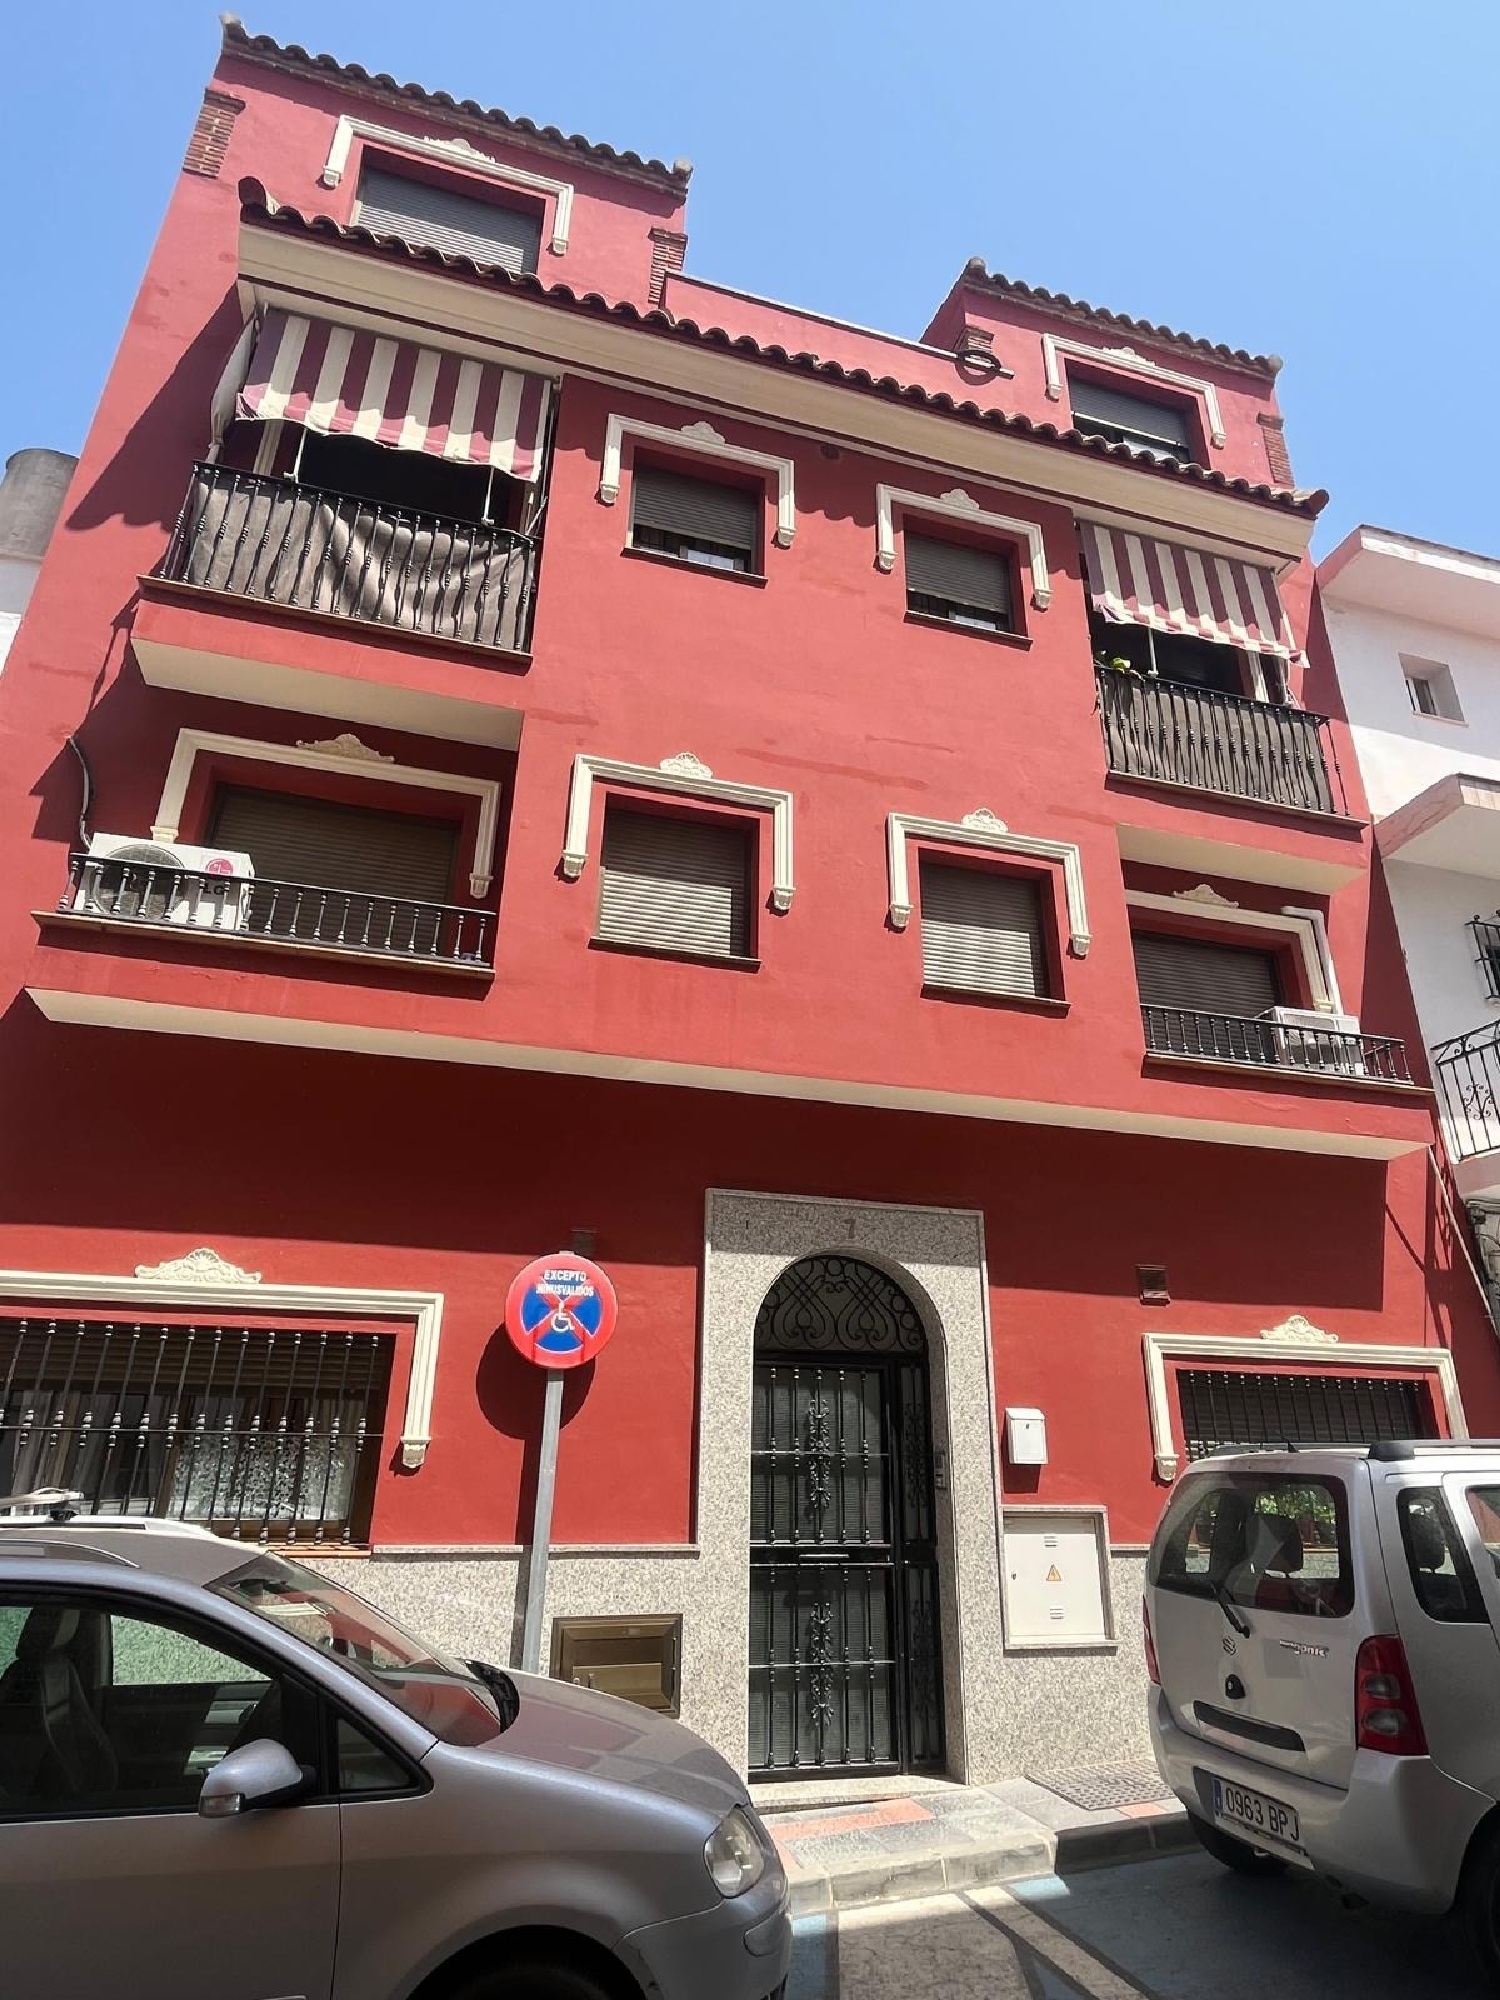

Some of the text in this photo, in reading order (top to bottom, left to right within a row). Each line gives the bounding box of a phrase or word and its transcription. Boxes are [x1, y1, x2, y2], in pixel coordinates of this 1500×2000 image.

[203, 882, 224, 896] LG
[543, 1269, 587, 1282] EXCEPTO
[1226, 1788, 1264, 1826] 0963
